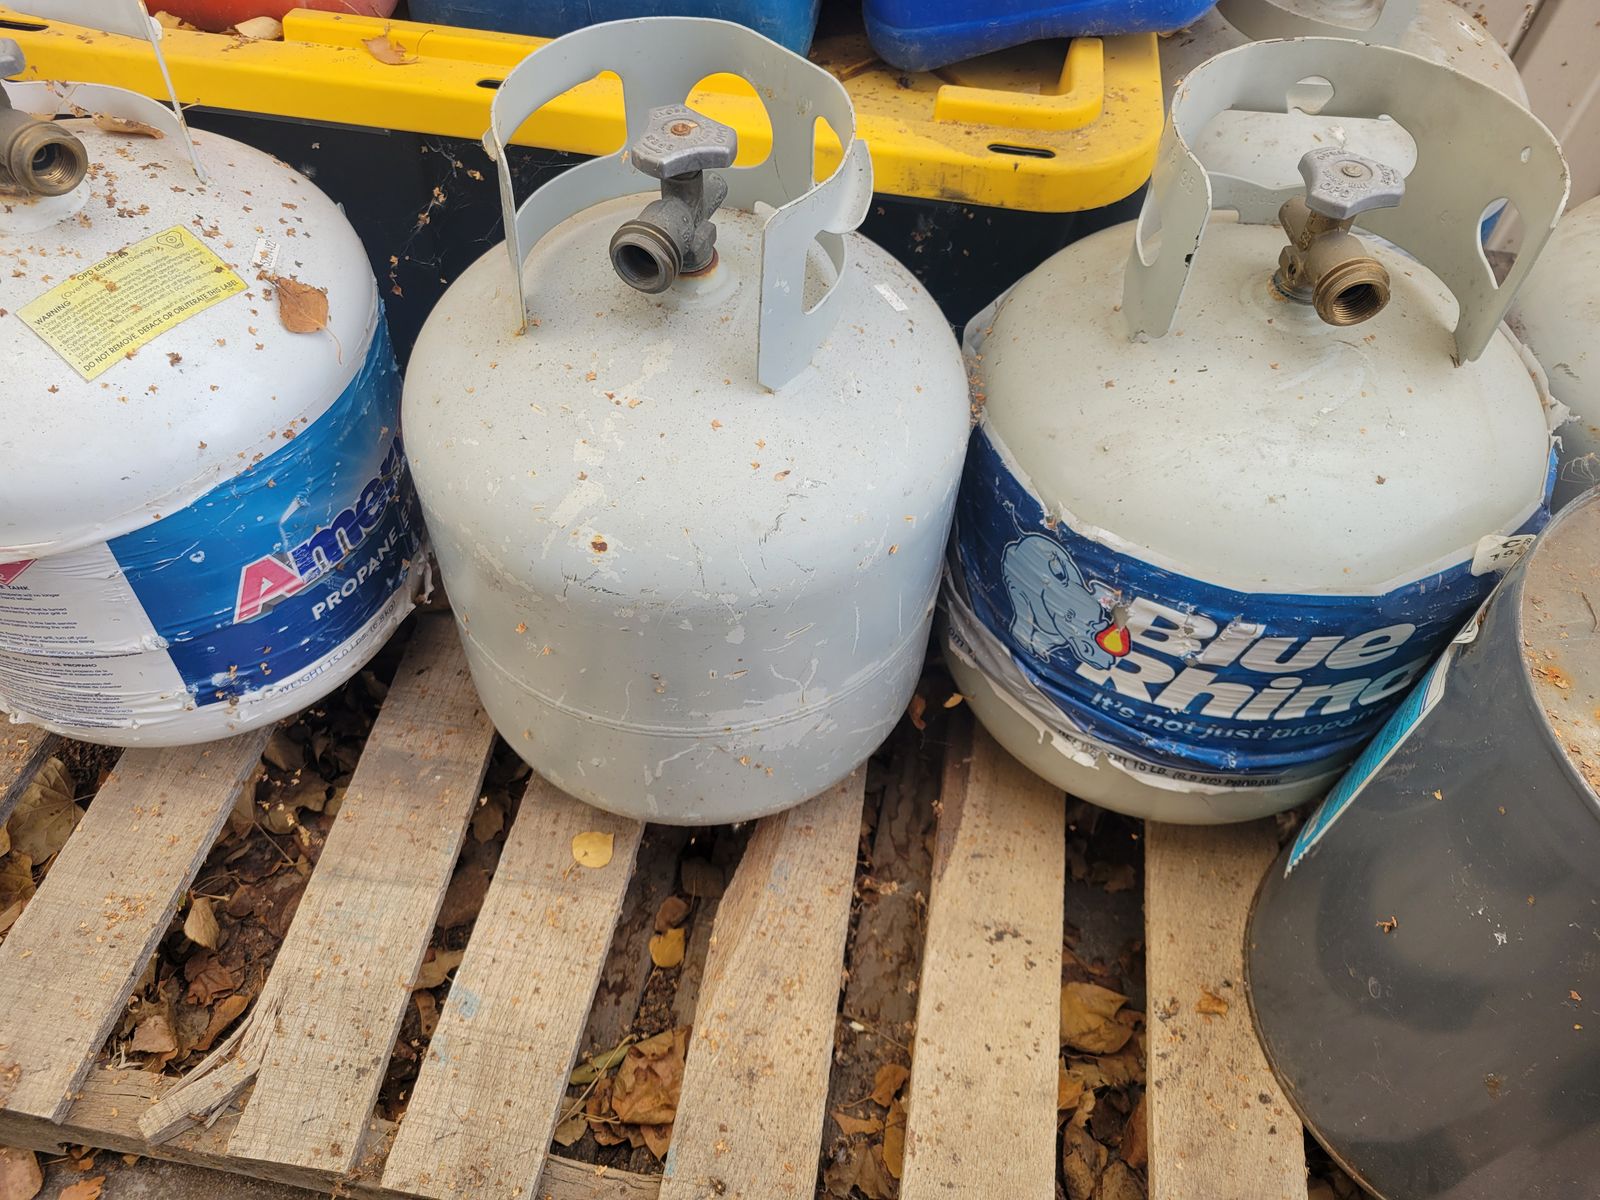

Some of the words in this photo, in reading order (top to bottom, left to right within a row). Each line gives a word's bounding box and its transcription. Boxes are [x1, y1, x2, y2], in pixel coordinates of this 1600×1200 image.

[75, 268, 94, 281] OPD
[87, 258, 129, 283] Pvention
[34, 299, 71, 325] WARNING
[83, 360, 96, 371] DO
[94, 350, 111, 363] NOT
[137, 317, 164, 335] DEFACE
[161, 311, 174, 320] OR
[172, 293, 208, 314] OBLITERATE
[206, 286, 221, 296] THIS
[219, 278, 238, 290] LABEL
[311, 526, 398, 621] PROPANE
[1124, 596, 1417, 673] Blue
[1089, 692, 1136, 718] It's
[1142, 713, 1195, 734] not
[1198, 724, 1266, 741] just
[1270, 706, 1378, 740] propan
[1133, 761, 1147, 771] 15
